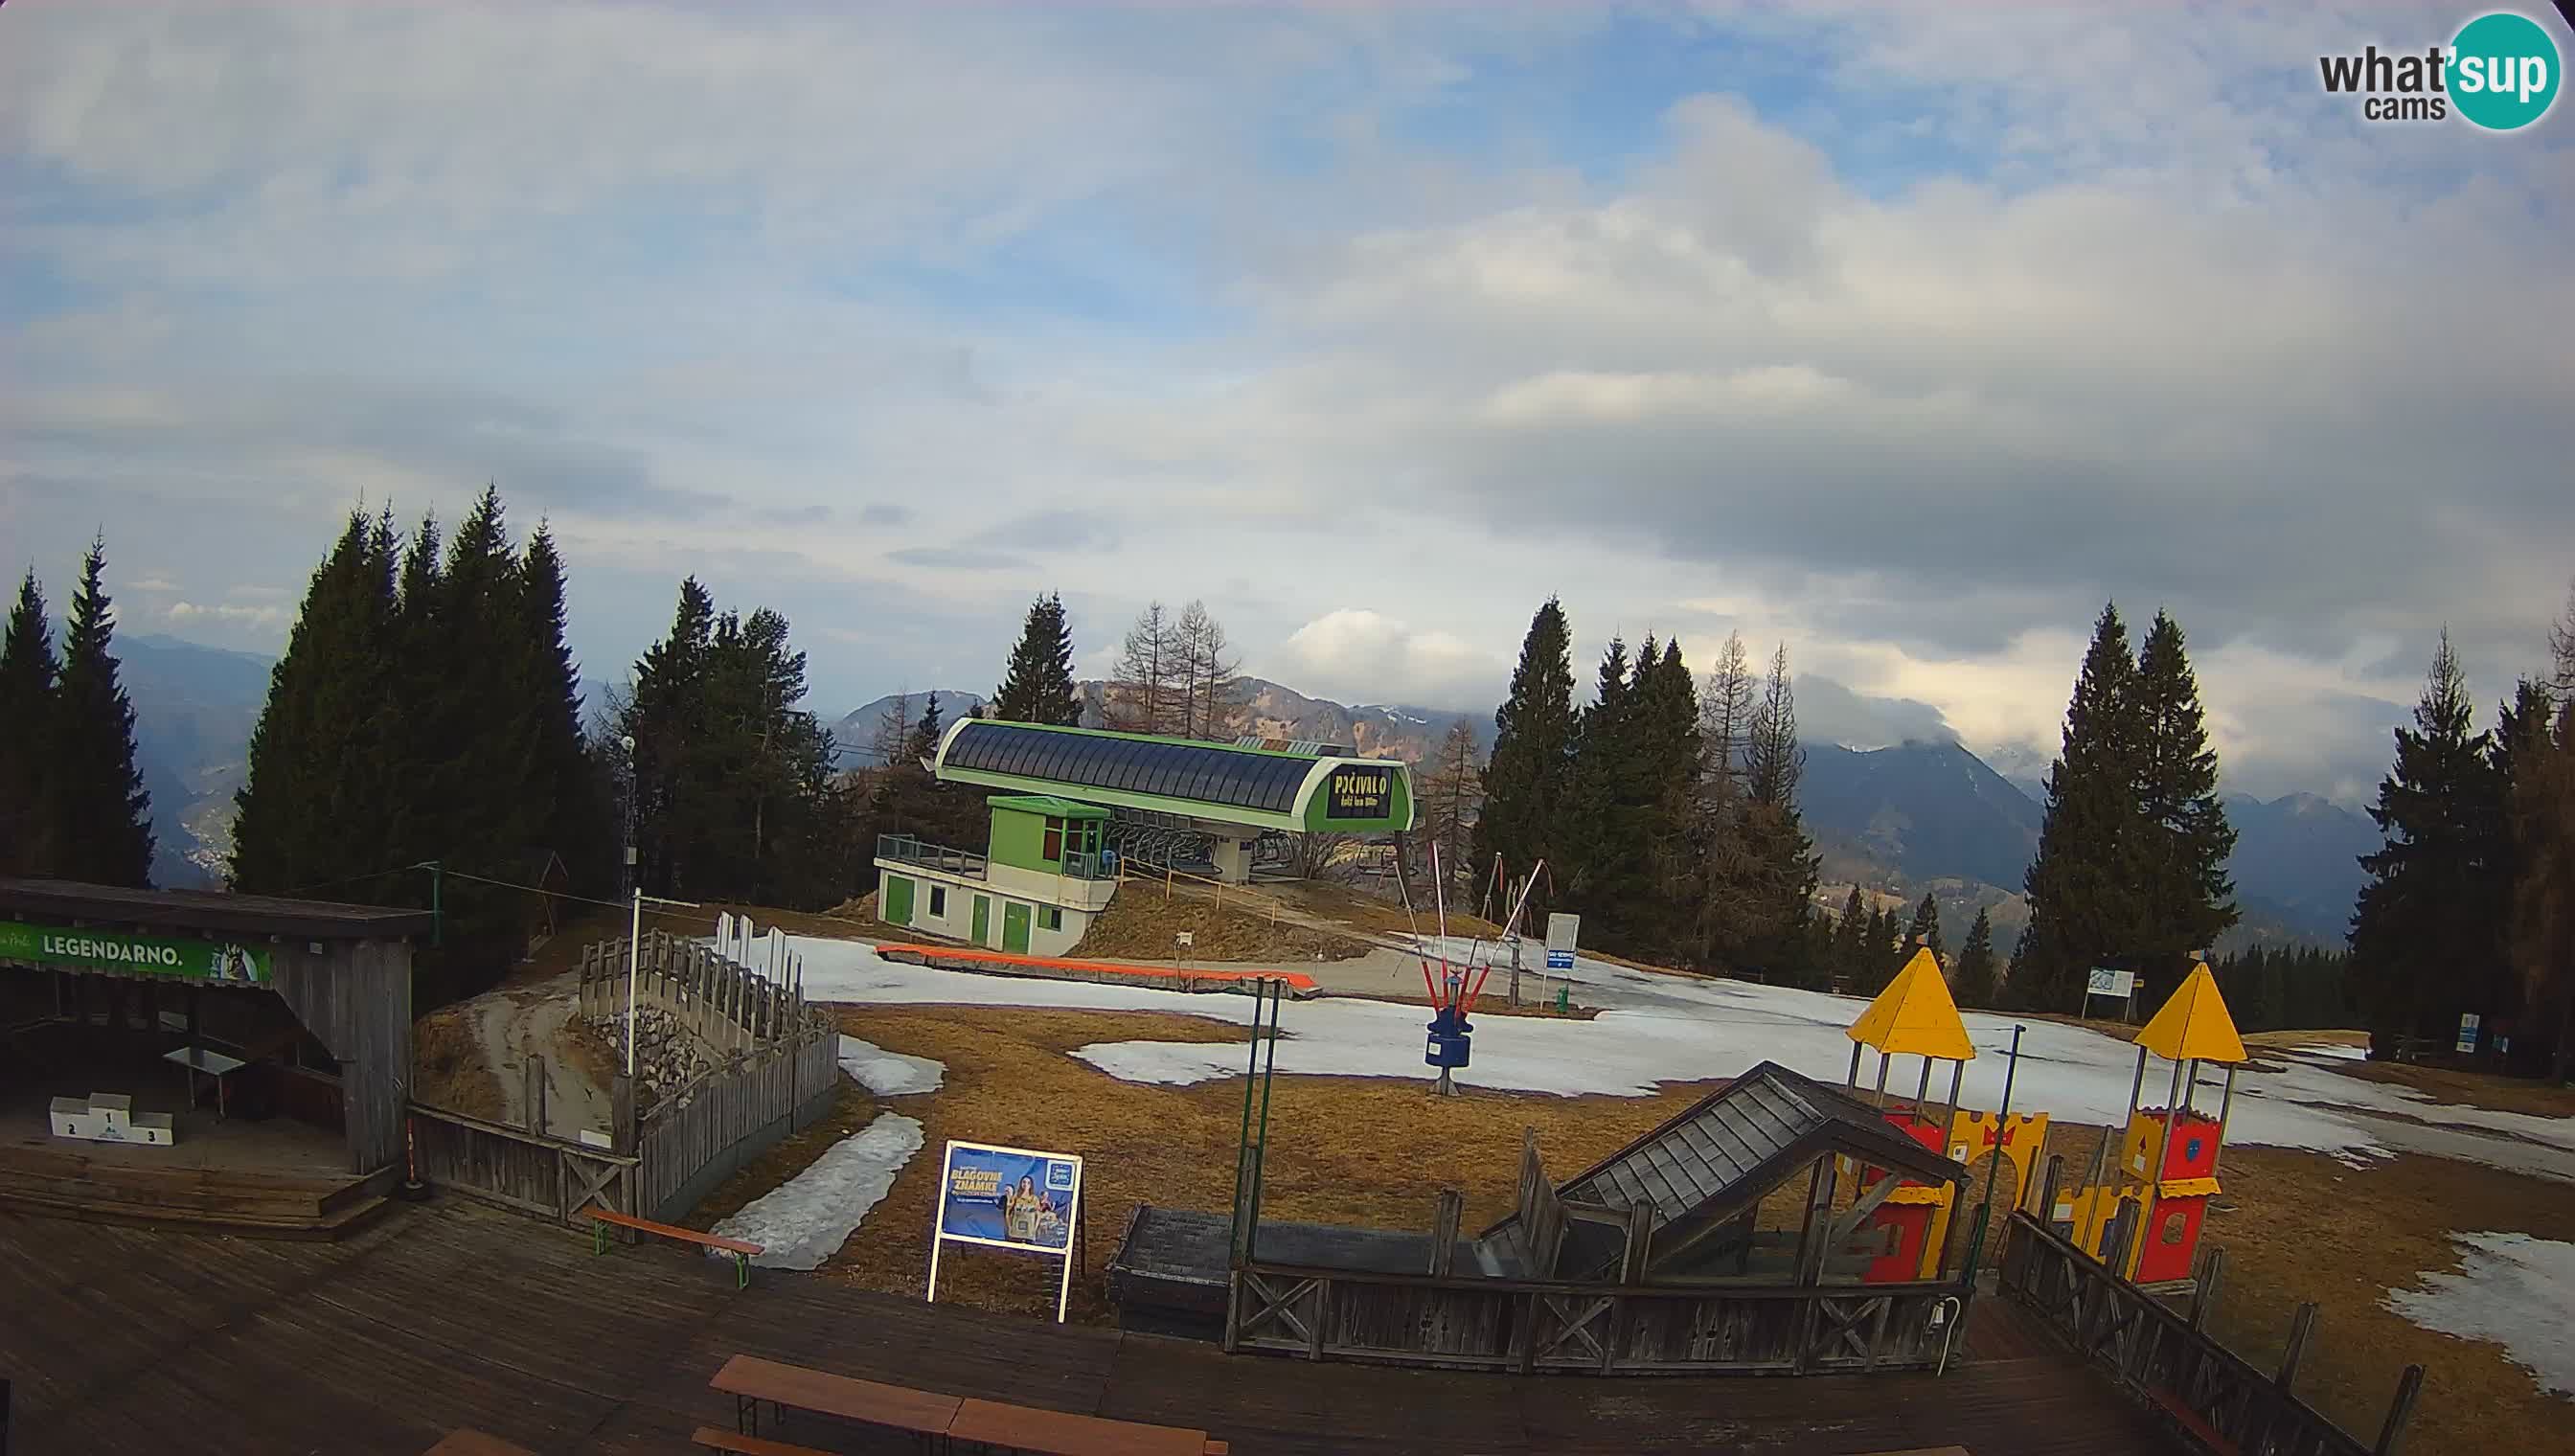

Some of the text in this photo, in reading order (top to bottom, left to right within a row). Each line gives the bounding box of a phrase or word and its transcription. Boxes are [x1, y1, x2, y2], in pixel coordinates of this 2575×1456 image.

[43, 935, 183, 966] LEGENDARNO.
[105, 1112, 112, 1124] 1
[68, 1124, 77, 1135] 2
[148, 1131, 156, 1142] 3
